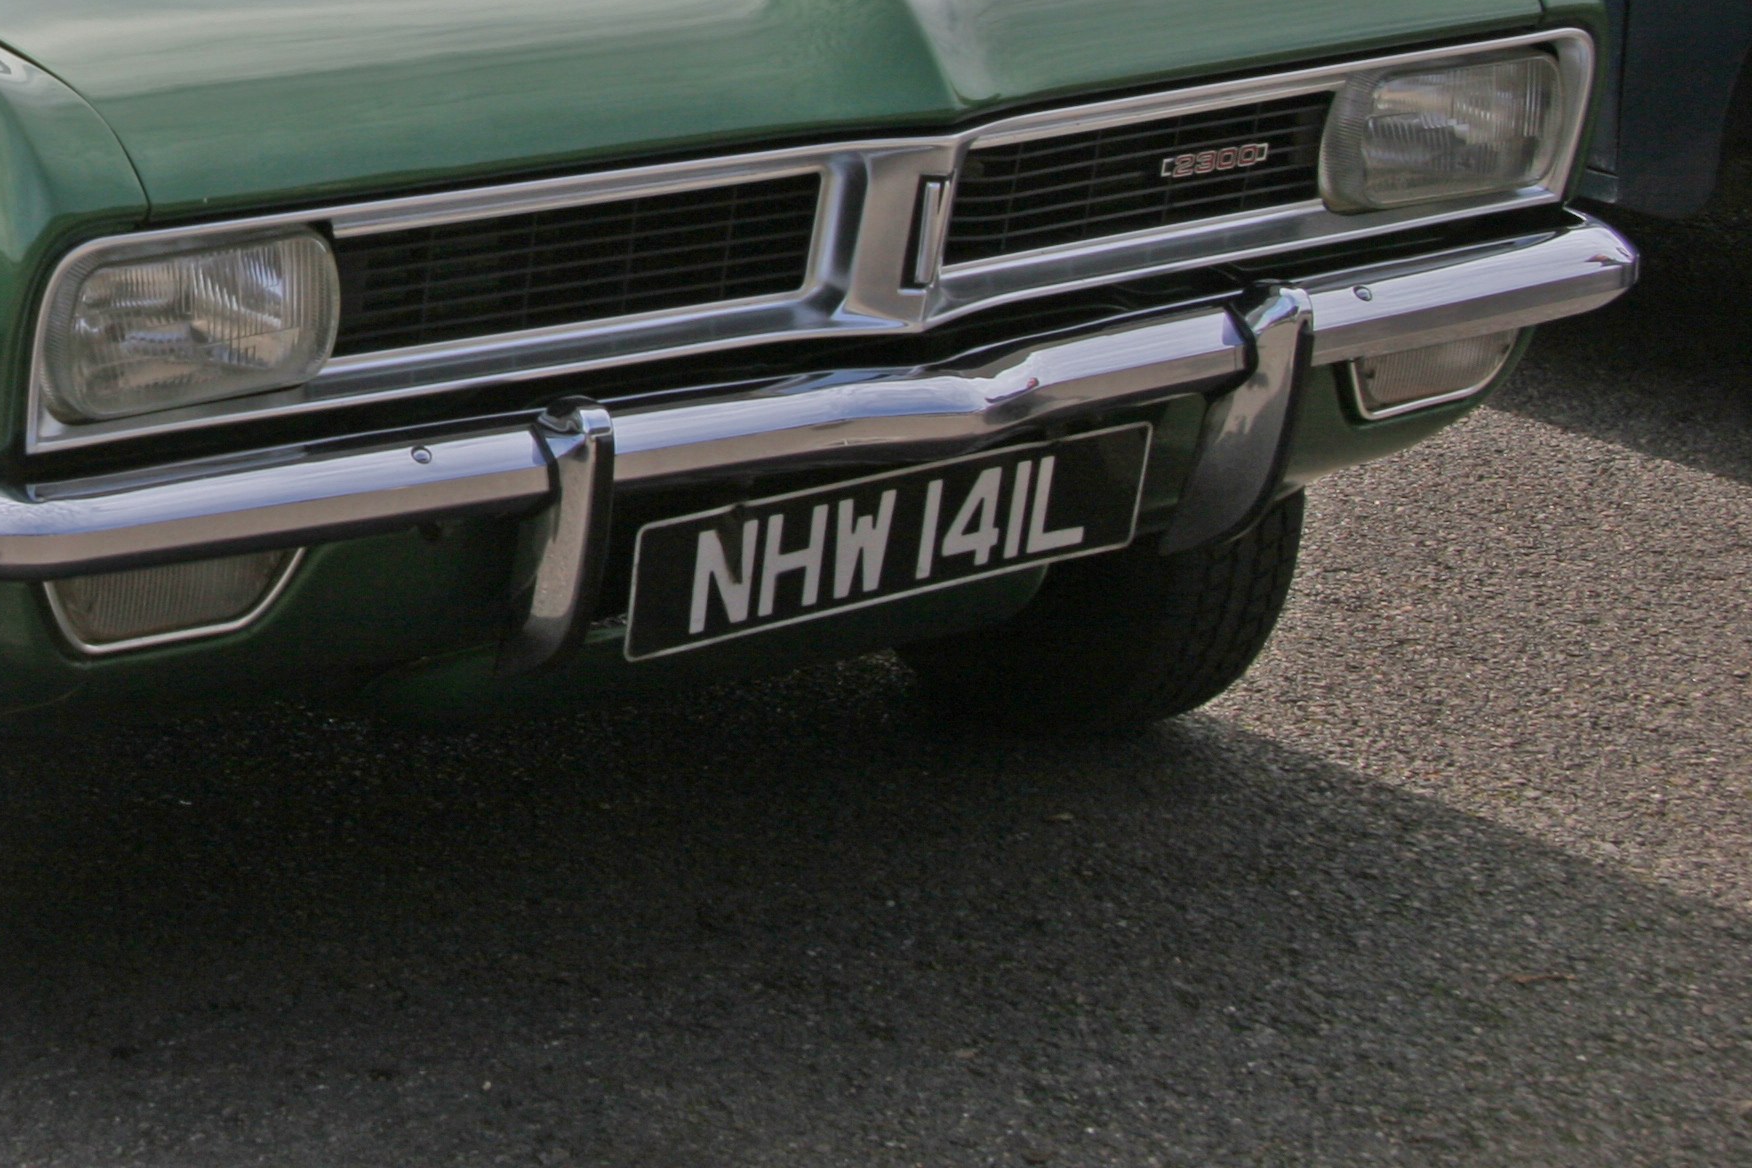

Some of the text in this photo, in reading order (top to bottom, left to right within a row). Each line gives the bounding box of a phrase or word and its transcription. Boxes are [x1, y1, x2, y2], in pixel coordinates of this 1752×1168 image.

[1172, 144, 1258, 178] 2300
[689, 455, 1084, 634] NHW 141L
